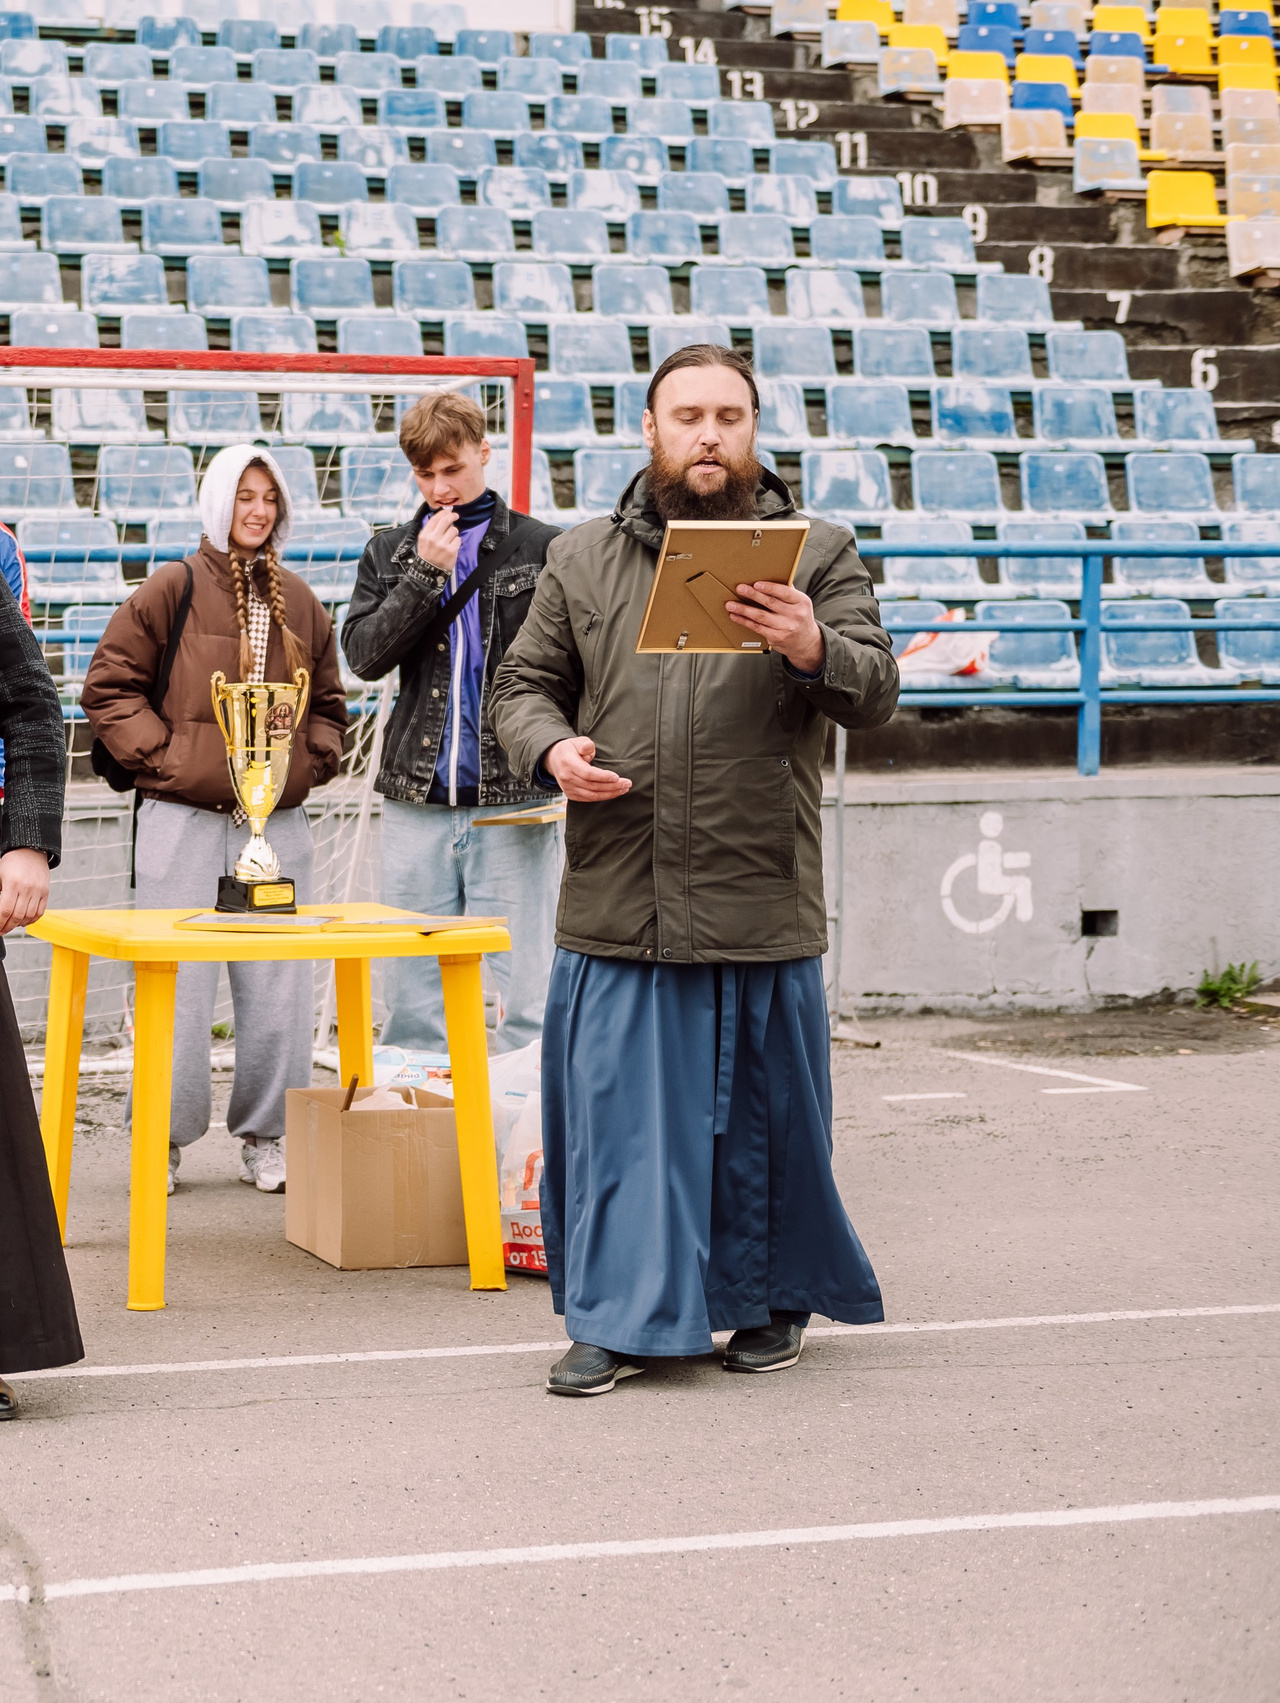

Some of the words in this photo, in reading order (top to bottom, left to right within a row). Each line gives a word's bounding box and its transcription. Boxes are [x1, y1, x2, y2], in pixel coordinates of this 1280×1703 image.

[634, 6, 672, 39] 15
[679, 36, 718, 65] 14
[727, 70, 764, 101] 13
[780, 99, 819, 130] 12
[835, 132, 868, 169] 11
[895, 172, 938, 206] 10
[962, 204, 988, 243] 9
[1028, 245, 1055, 284] 8
[1107, 292, 1131, 324] 7
[1190, 348, 1219, 391] 6
[509, 1251, 528, 1265] от
